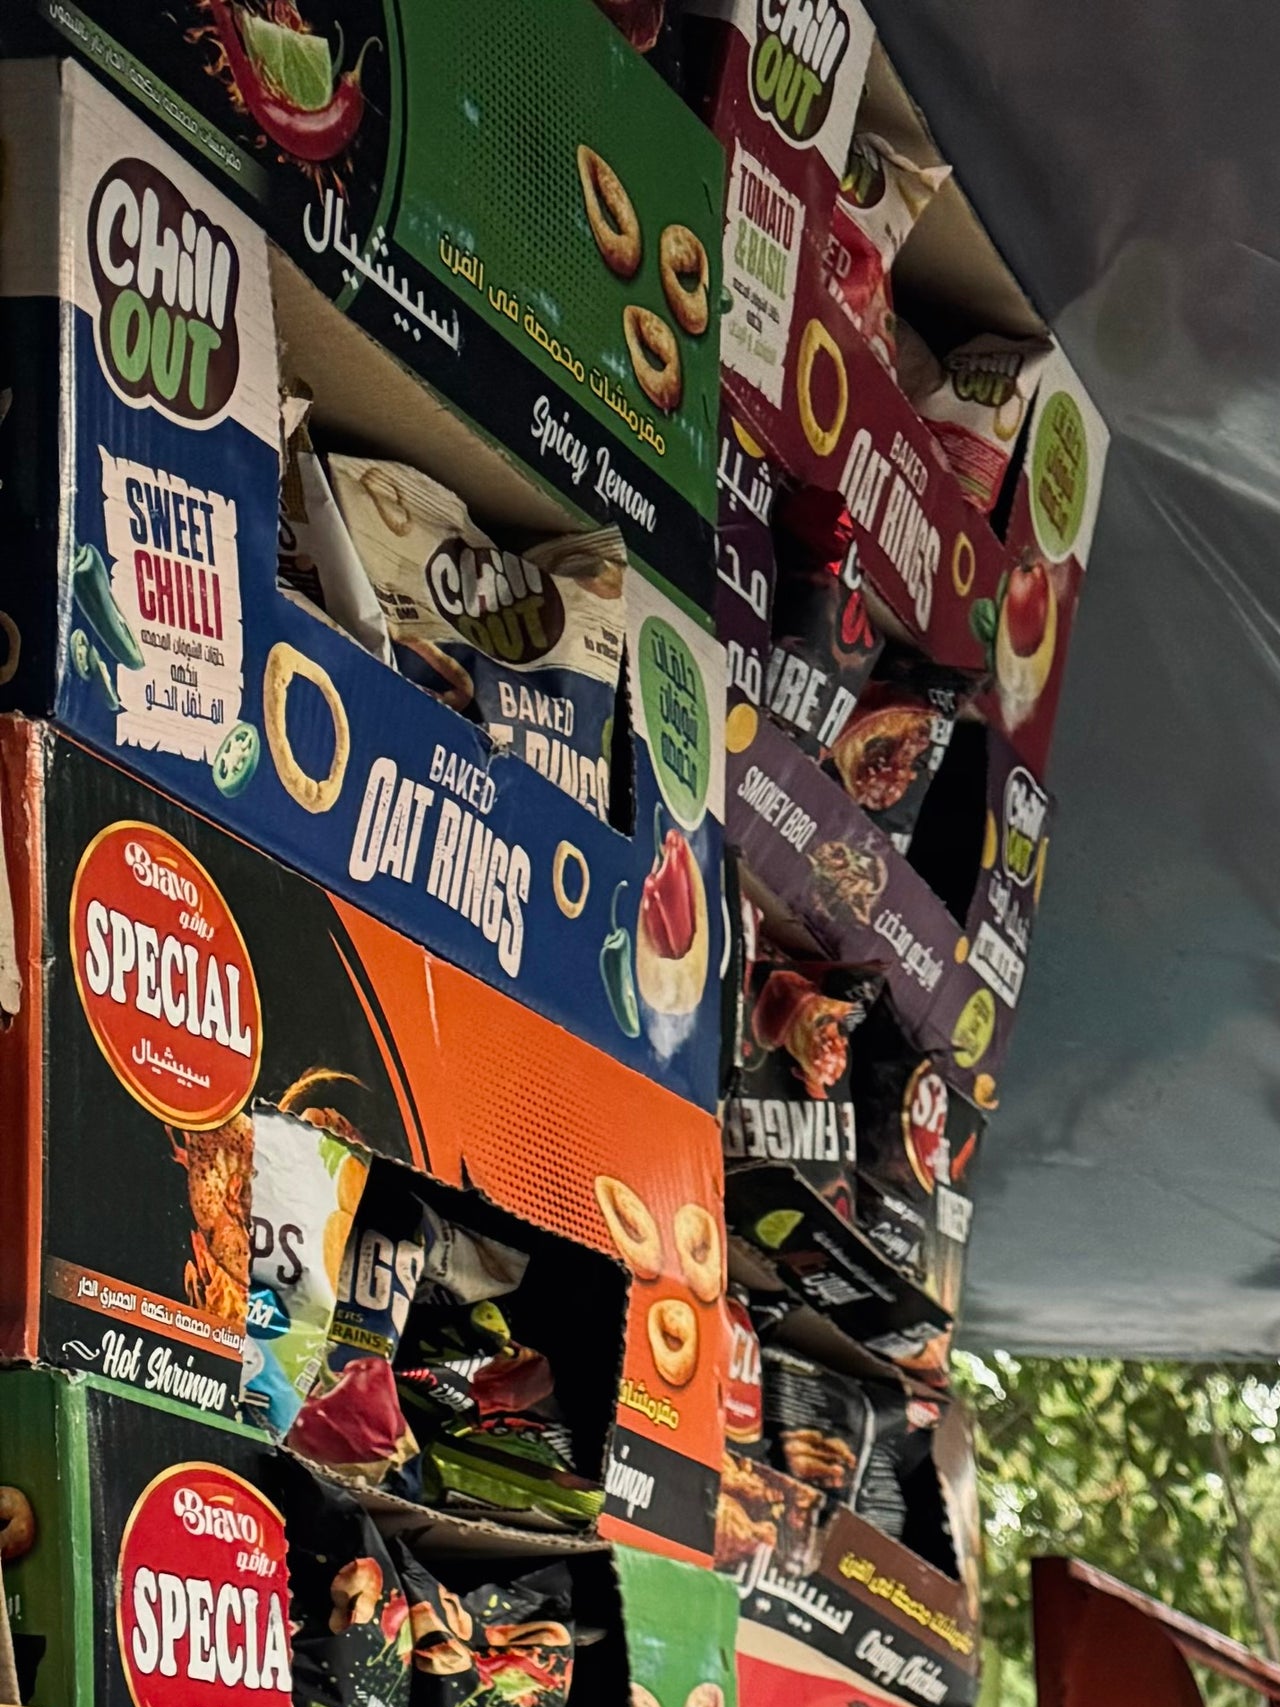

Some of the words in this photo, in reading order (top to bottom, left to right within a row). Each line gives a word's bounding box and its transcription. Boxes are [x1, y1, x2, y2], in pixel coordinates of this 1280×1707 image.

[756, 34, 821, 135] OUT
[739, 164, 795, 250] TOMATO
[302, 189, 464, 354] سبيشيال
[439, 232, 485, 290] الفرن
[109, 290, 221, 410] OUT
[524, 309, 585, 383] محمصة
[590, 366, 666, 455] مقرمشات
[531, 395, 588, 481] Spicy
[593, 456, 656, 533] Lemon
[126, 477, 217, 567] SWEET
[838, 428, 891, 533] OAT
[878, 473, 941, 632] RINGS
[134, 548, 224, 640] CHILLI
[457, 595, 549, 661] OUT
[499, 682, 575, 737] BAKED
[430, 745, 496, 815] BAKED
[736, 765, 792, 835] SMOKEY
[787, 810, 818, 856] BBQ
[125, 841, 199, 909] Bravo
[349, 757, 433, 882] OAT
[426, 802, 531, 979] RINGS
[85, 900, 252, 1060] SPECIAL
[132, 1038, 211, 1089] سبيشيال
[102, 1330, 143, 1379] Hot
[145, 1346, 228, 1413] Shrimps
[174, 1487, 259, 1545] Bravo
[132, 1566, 292, 1693] SPECIA
